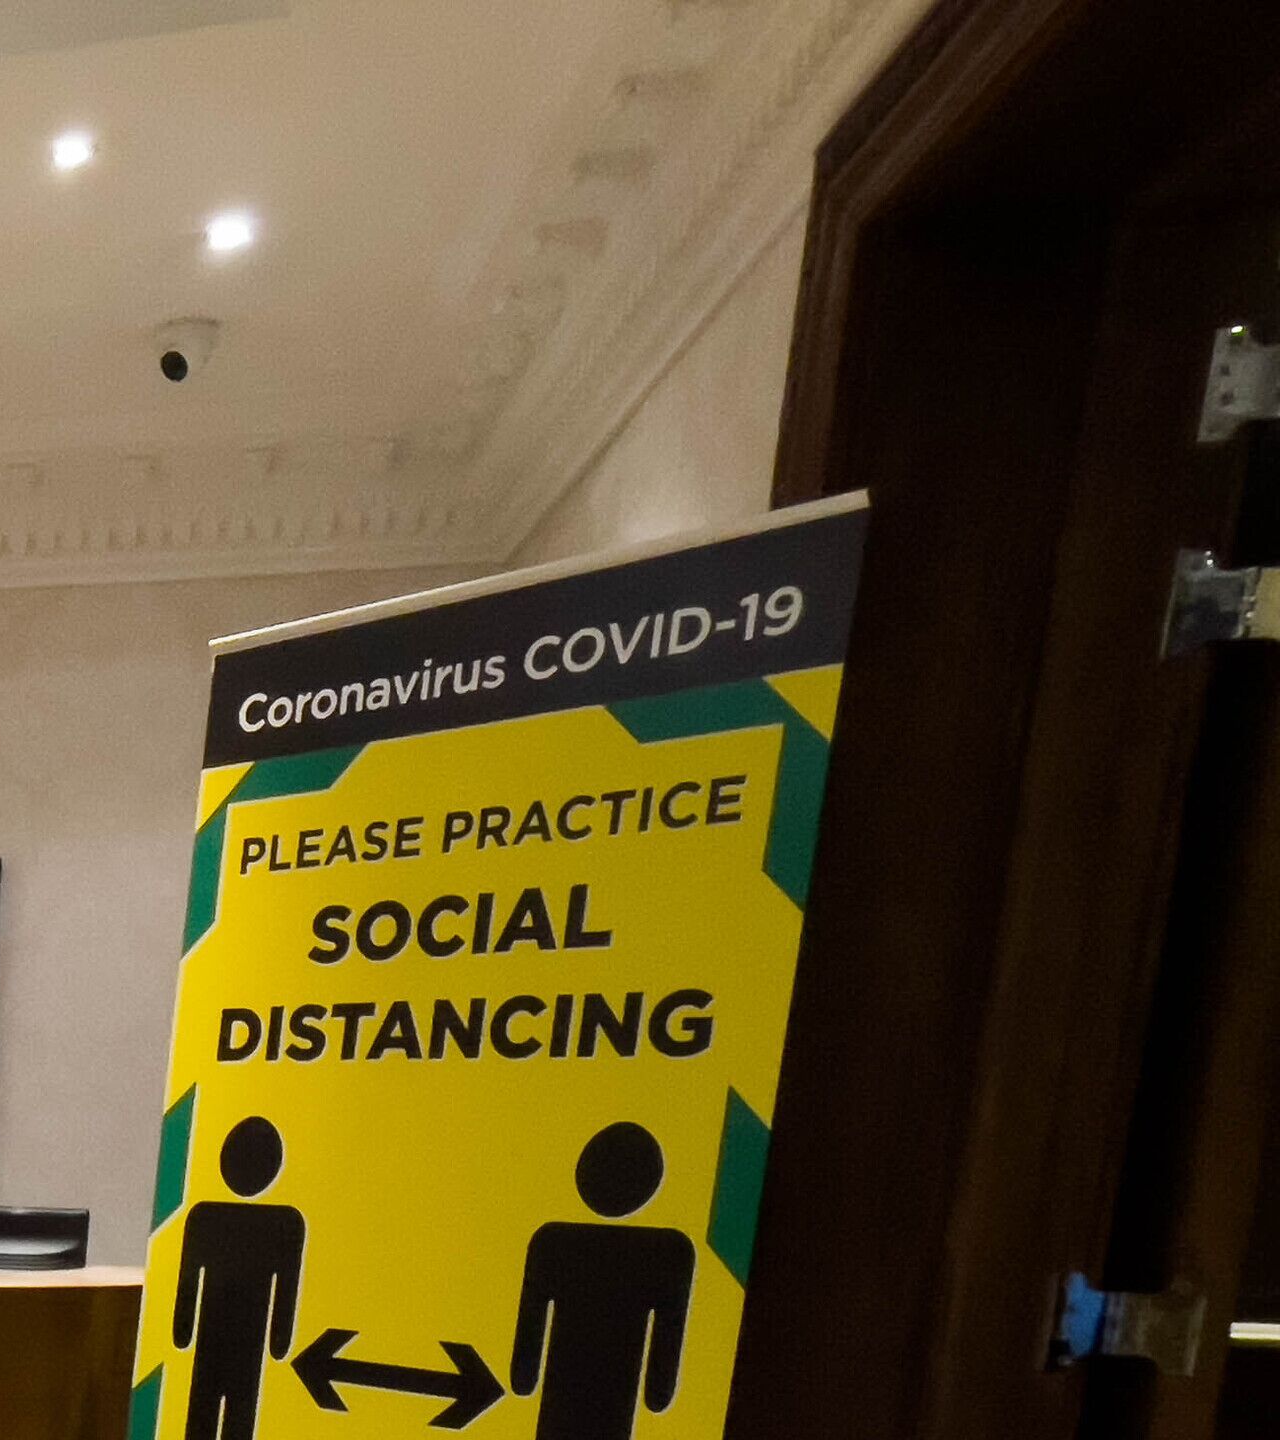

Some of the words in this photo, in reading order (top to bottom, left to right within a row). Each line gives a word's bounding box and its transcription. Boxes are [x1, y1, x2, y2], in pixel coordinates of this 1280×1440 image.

[239, 652, 506, 732] Coronavirus
[524, 585, 804, 681] COVID-19
[239, 816, 424, 875] PLEASE
[442, 775, 746, 854] PRACTICE
[308, 884, 612, 965] SOCIAL
[217, 988, 714, 1062] DISTANCING
